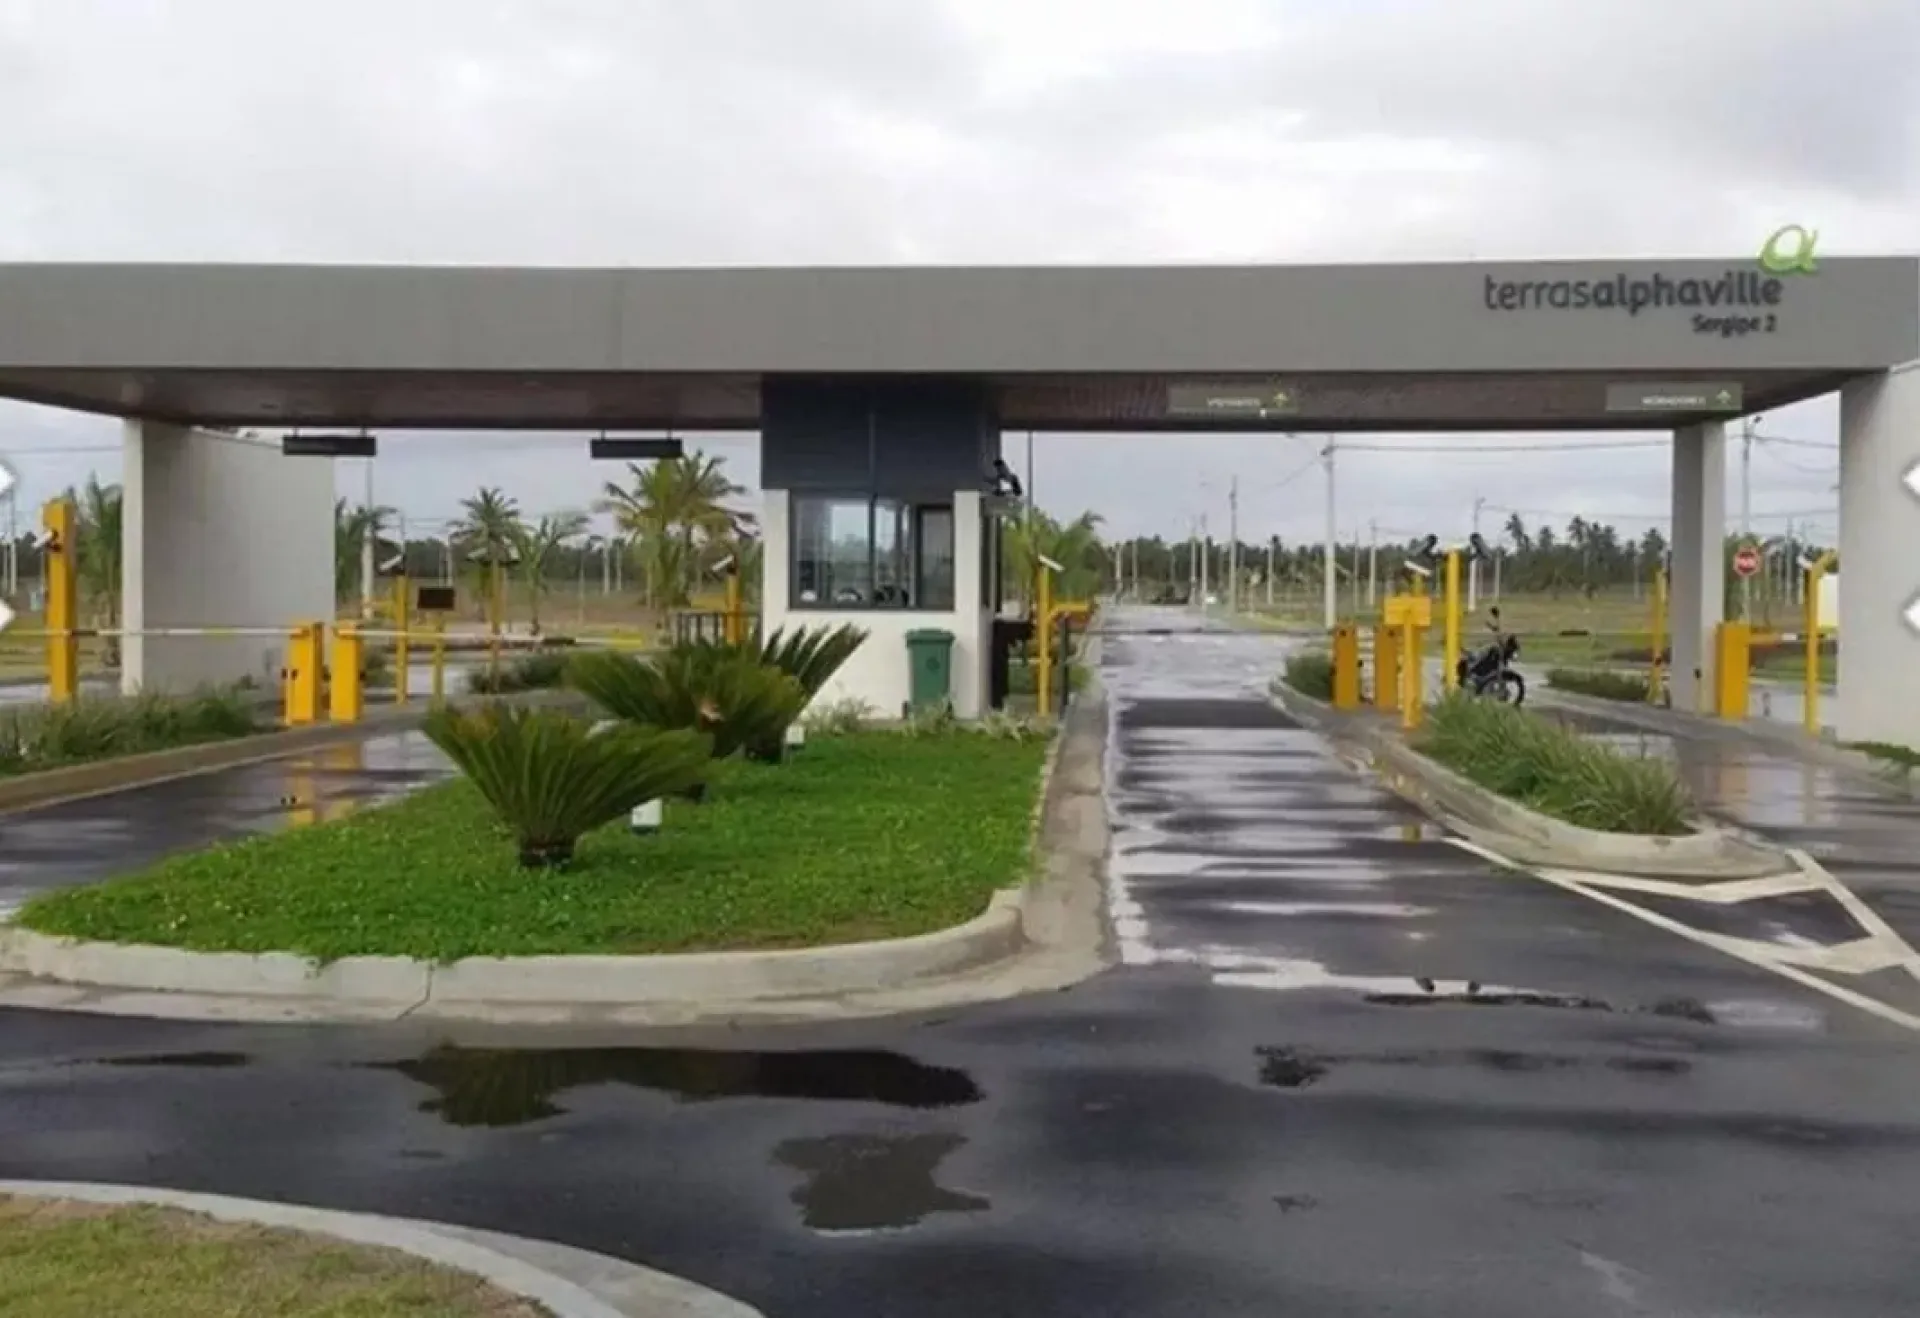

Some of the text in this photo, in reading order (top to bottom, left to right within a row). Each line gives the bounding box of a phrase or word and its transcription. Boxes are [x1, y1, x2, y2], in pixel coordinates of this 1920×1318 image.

[1484, 271, 1783, 317] terrasalphaville
[1692, 312, 1778, 338] Sergipe 2
